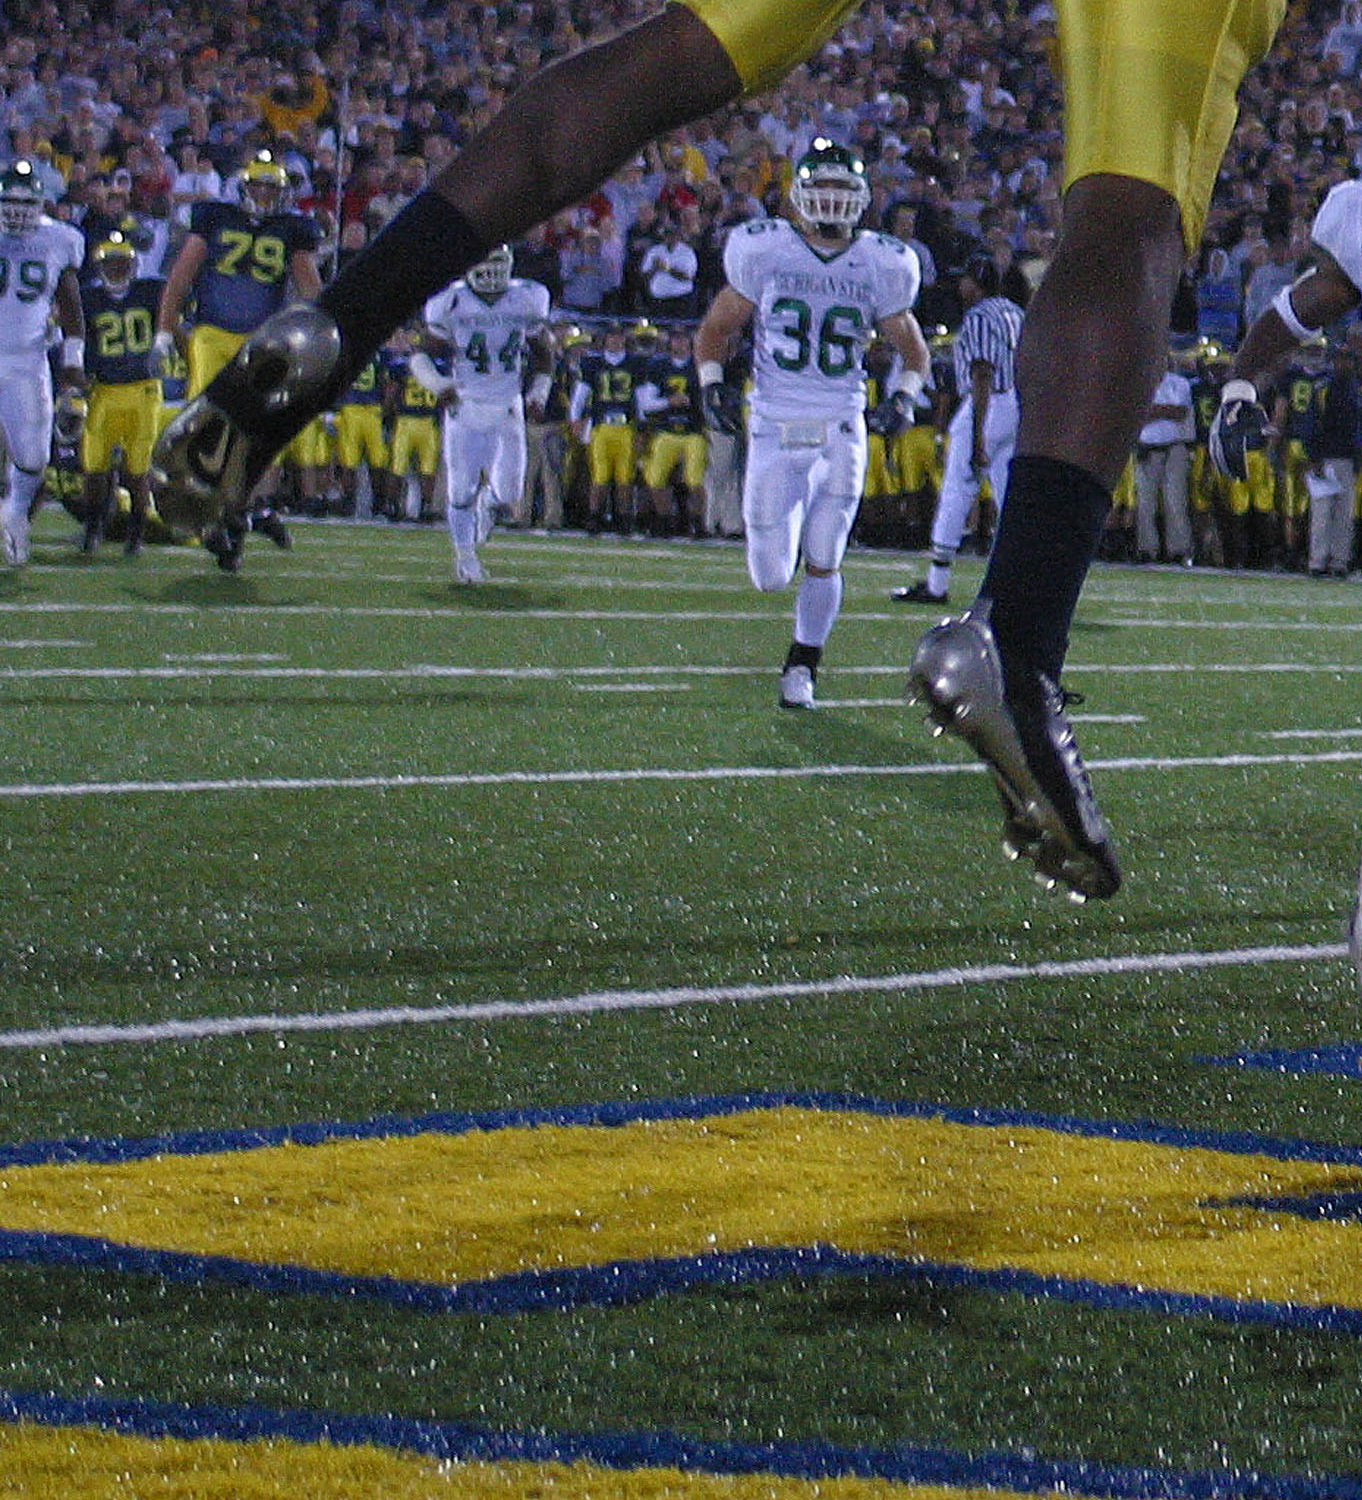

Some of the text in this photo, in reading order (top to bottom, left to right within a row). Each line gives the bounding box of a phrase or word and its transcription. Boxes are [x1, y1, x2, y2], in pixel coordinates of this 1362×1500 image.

[0, 257, 48, 303] 9
[216, 229, 287, 284] 79
[96, 307, 152, 357] 20
[465, 329, 521, 374] 44
[770, 298, 864, 377] 36
